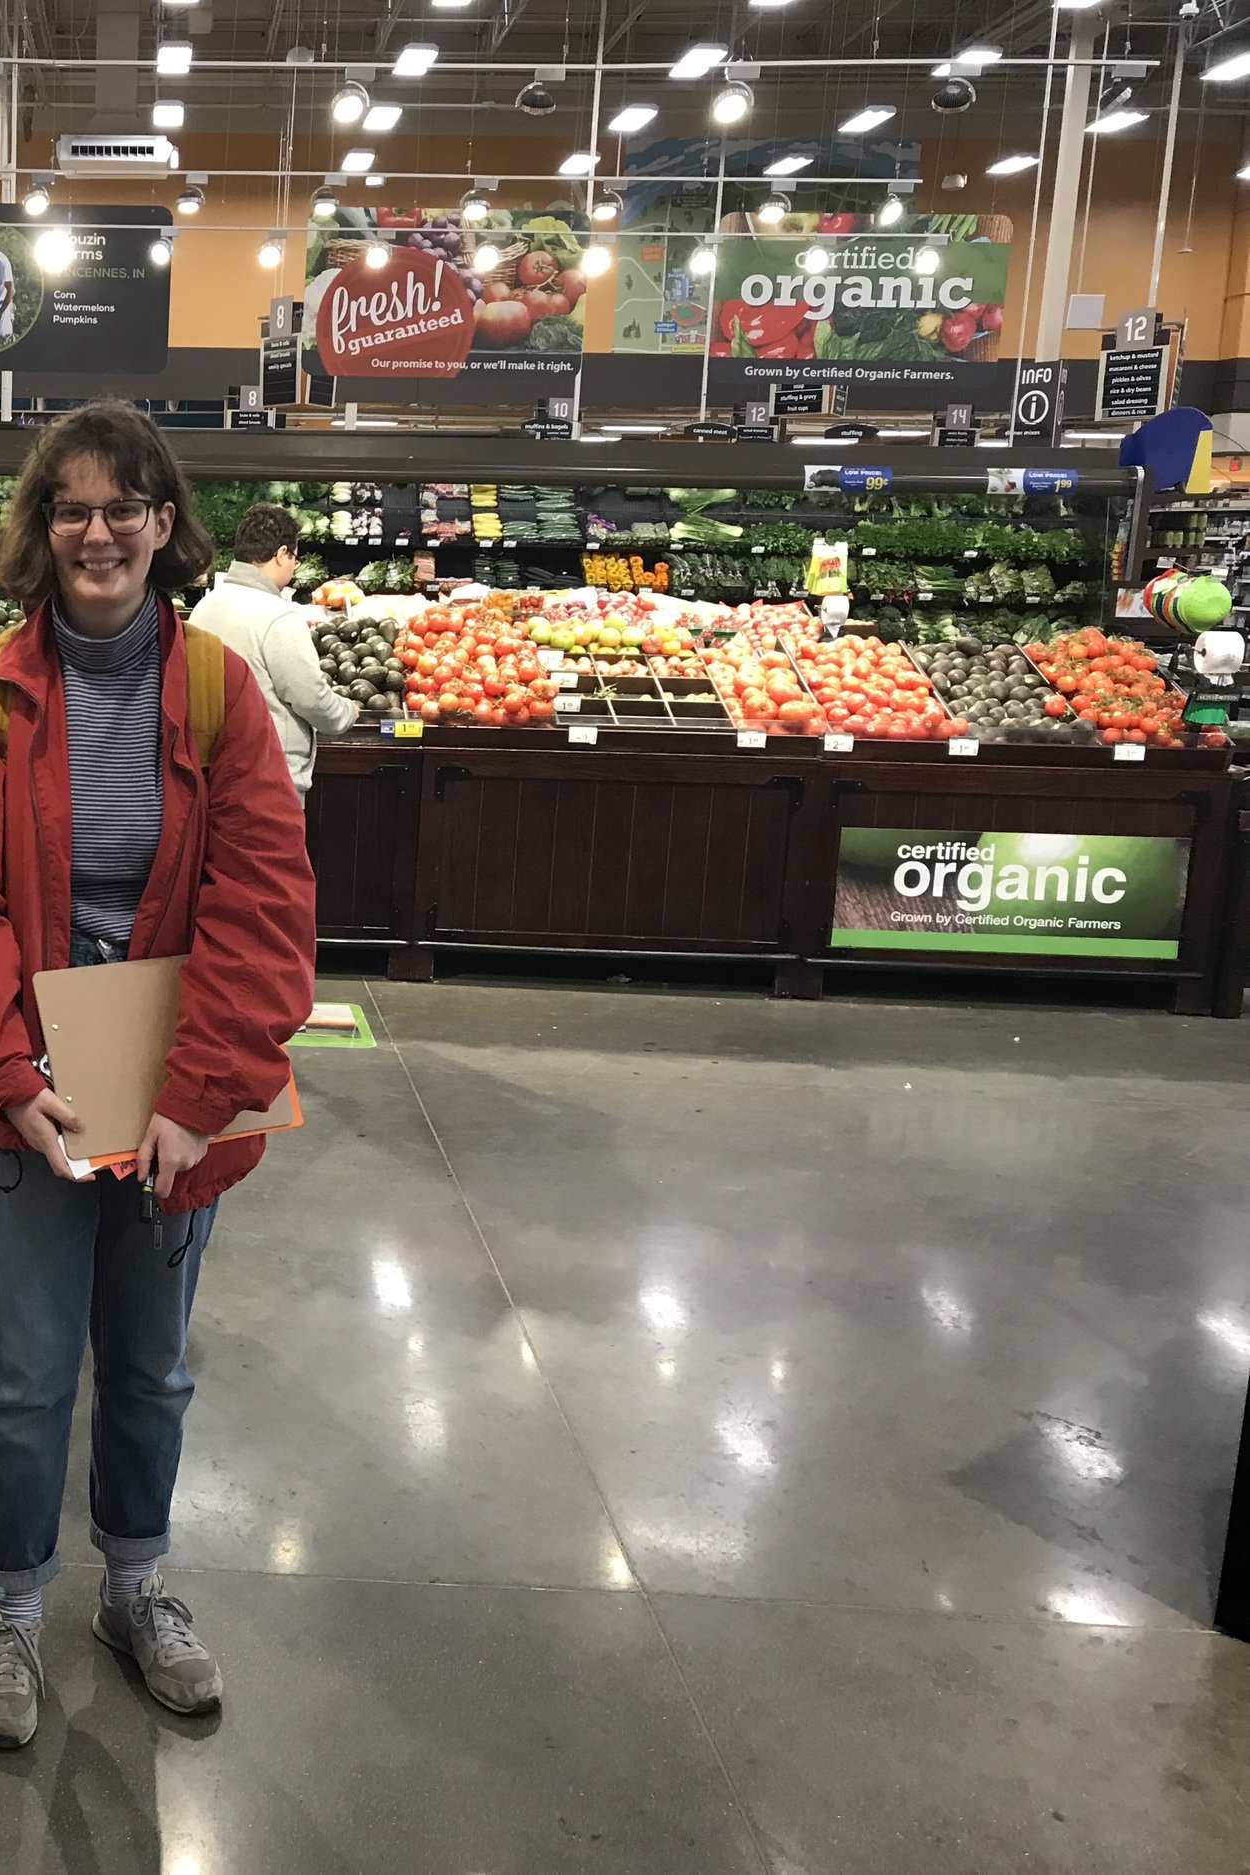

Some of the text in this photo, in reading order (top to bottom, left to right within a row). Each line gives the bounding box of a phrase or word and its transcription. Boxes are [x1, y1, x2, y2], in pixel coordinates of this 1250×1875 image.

[69, 233, 106, 246] ouzin
[795, 247, 912, 270] crtified
[133, 268, 145, 278] IN
[54, 291, 76, 300] Corn
[741, 272, 973, 320] organic
[54, 303, 115, 313] Watermelons
[331, 259, 445, 354] fresh!
[53, 315, 98, 325] Pumpkins
[276, 304, 285, 329] 8
[347, 308, 464, 356] guaranteed
[1124, 316, 1148, 342] 12
[371, 358, 574, 373] Our promise to you, or we'll make it right.
[744, 366, 954, 381] Grown by Certified Organic Farmers.
[1022, 368, 1052, 384] INFO
[249, 391, 256, 406] 8
[554, 403, 568, 417] 10
[751, 407, 765, 421] 12
[952, 409, 967, 424] 14
[897, 842, 995, 862] certified
[894, 856, 1127, 912] organic
[890, 911, 1121, 930] Grown by Certified Organic Farmers
